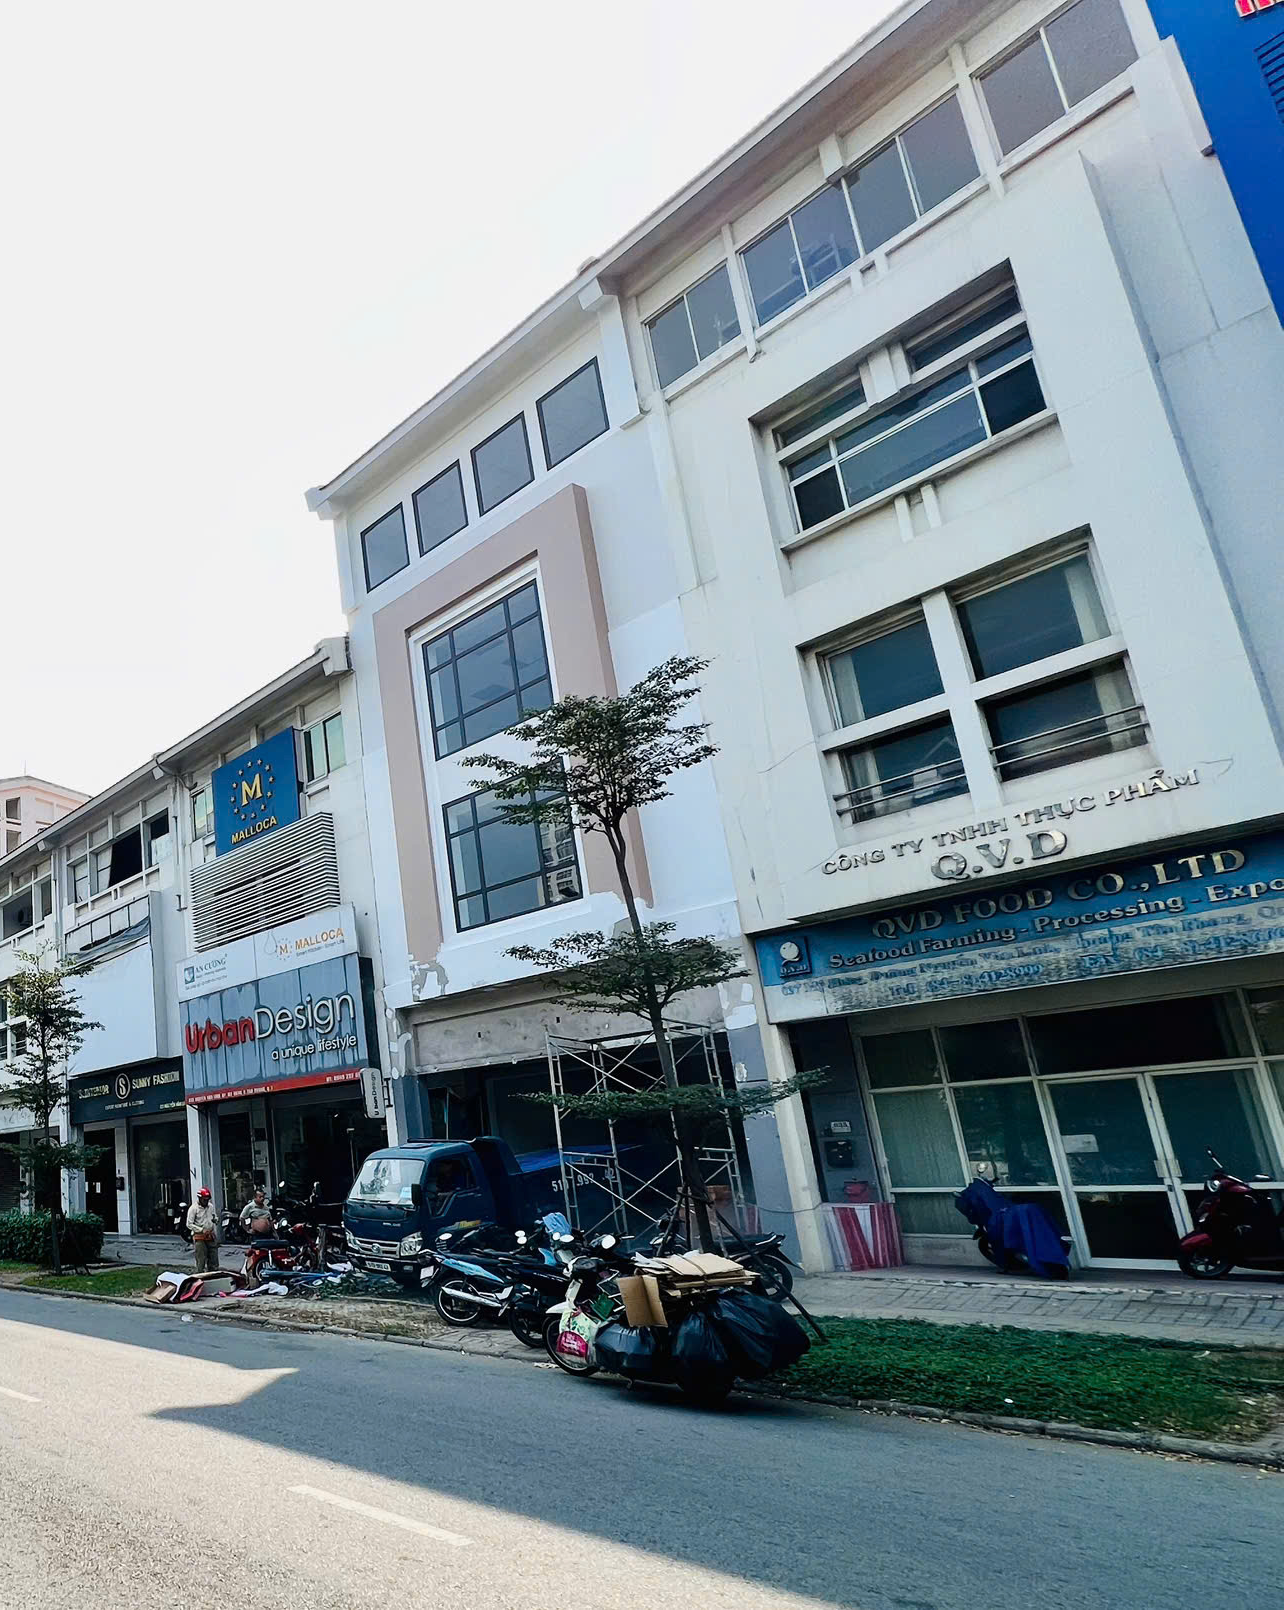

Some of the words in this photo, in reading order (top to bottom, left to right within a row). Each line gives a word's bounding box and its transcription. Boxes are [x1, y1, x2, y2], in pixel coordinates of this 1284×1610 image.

[231, 815, 277, 844] MALLOCA
[821, 848, 886, 876] CÔNG
[891, 838, 925, 858] TY
[931, 816, 1009, 848] TNHH
[1014, 795, 1097, 827] THỰC
[1102, 769, 1201, 806] PHẨM
[931, 828, 1067, 880] Q.V.D
[294, 928, 344, 950] MALLOCA
[829, 940, 916, 969] Seafood
[920, 926, 1017, 955] Farming
[1033, 895, 1185, 934] Processing
[872, 910, 943, 939] QVD
[953, 888, 1053, 925] FOOD
[271, 1050, 280, 1061] a
[281, 1043, 315, 1060] unique
[317, 1035, 357, 1053] lifestyle
